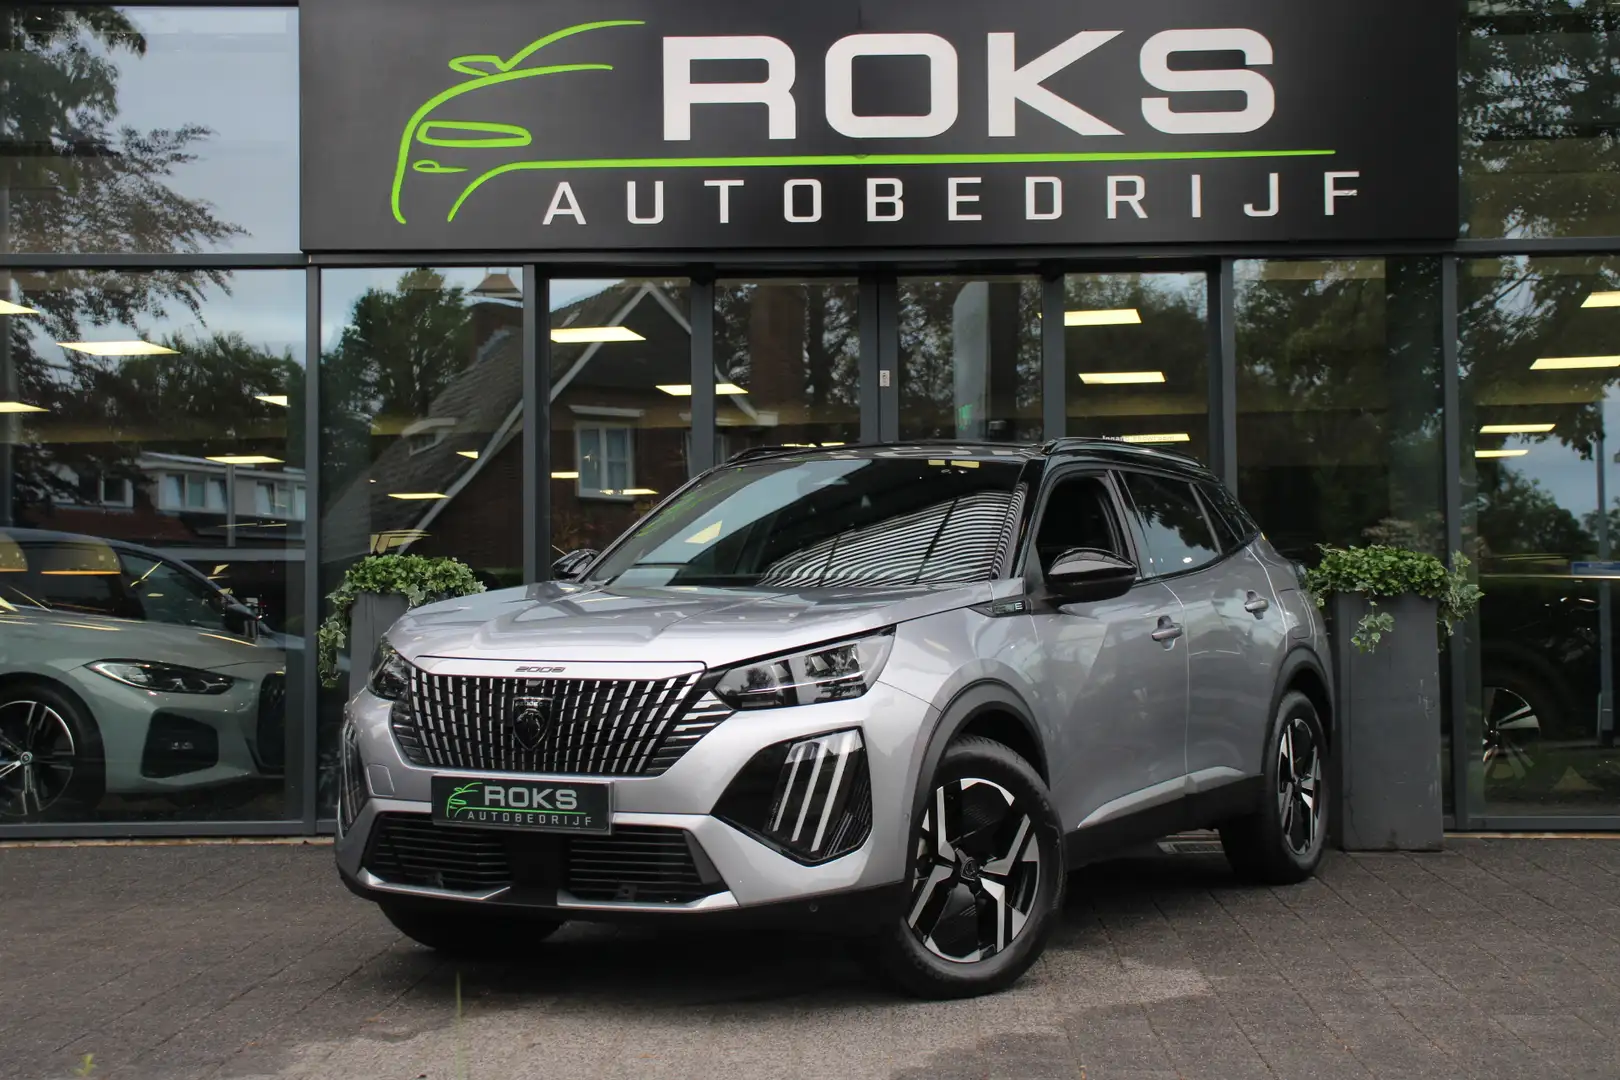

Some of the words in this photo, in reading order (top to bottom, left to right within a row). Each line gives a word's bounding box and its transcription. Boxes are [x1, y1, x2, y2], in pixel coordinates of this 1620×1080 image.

[662, 28, 1275, 141] ROKS
[543, 172, 1360, 225] AUTOBEDRIJF
[484, 785, 578, 810] ROKS
[467, 811, 592, 826] AUTOBEDRIJF
